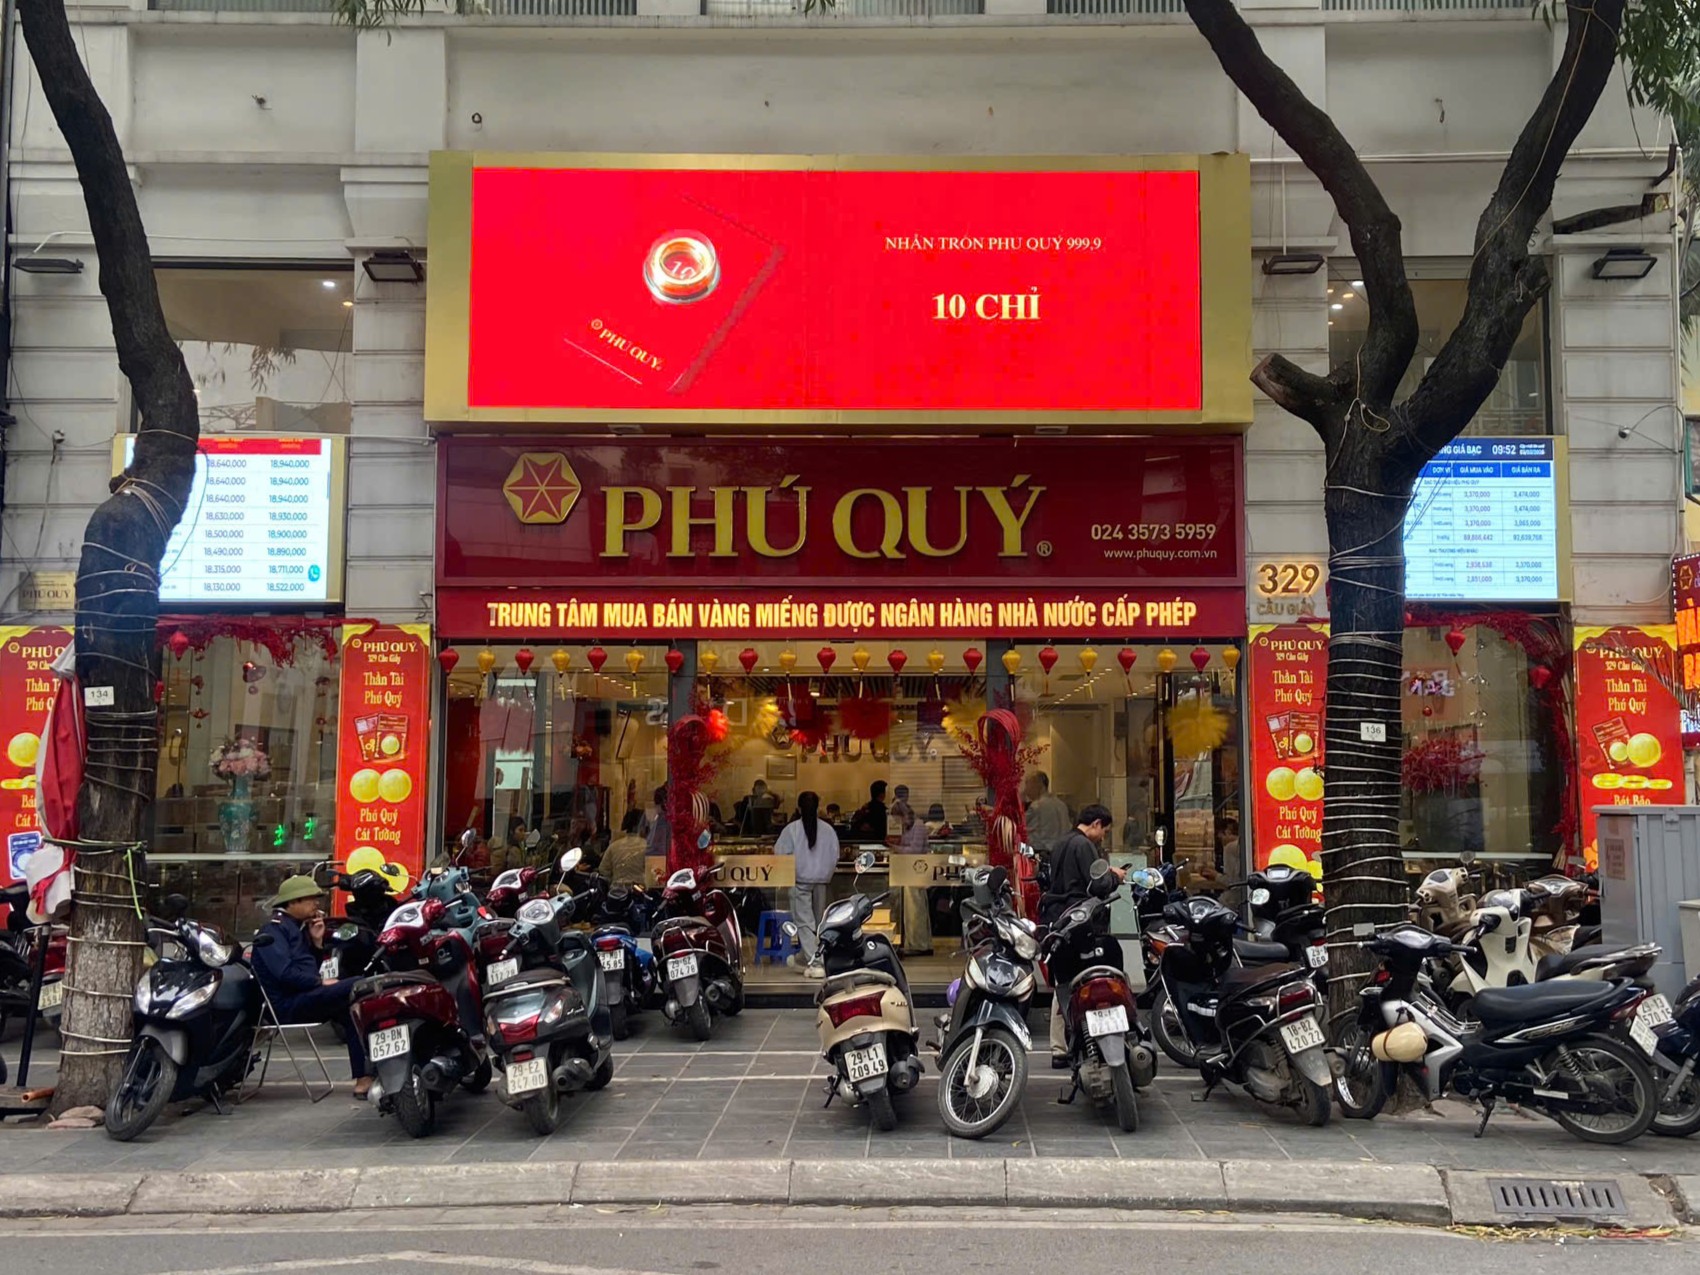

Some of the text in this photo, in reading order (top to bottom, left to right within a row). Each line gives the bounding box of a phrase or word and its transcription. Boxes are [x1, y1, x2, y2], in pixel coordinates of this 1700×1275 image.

[932, 285, 1041, 320] 10 CHỈ
[1491, 444, 1517, 455] 09:52
[599, 474, 1047, 559] PHÚ QUÝ
[1090, 523, 1217, 541] 024 3573 5959
[1103, 547, 1218, 562] www.phuquy.com.vn
[1257, 563, 1321, 595] 329
[487, 593, 1197, 633] TRUNG TÂM MUA BÁN VÀNG MIẾNG ĐƯỢC NGÂN HÀNG NHÀ NƯỚC CẤP PHÉP
[21, 645, 53, 658] PHÚ
[362, 641, 389, 652] PHÚ
[1270, 639, 1297, 651] PHÚ
[90, 690, 109, 699] 134
[364, 690, 402, 708] Phú Quý
[1275, 688, 1313, 706] Phú Quý
[1608, 696, 1647, 715] Phú Quý
[1365, 725, 1382, 734] 136
[360, 808, 398, 826] Phú Quý
[1279, 806, 1318, 824] Phú Quý
[355, 827, 370, 841] Cát
[1275, 825, 1291, 839] Cát
[730, 863, 773, 882] QUÝ
[374, 1027, 403, 1043] 29-BN
[372, 1039, 408, 1059] 057.62
[850, 1049, 880, 1065] 29-L1
[851, 1059, 886, 1080] 209.49
